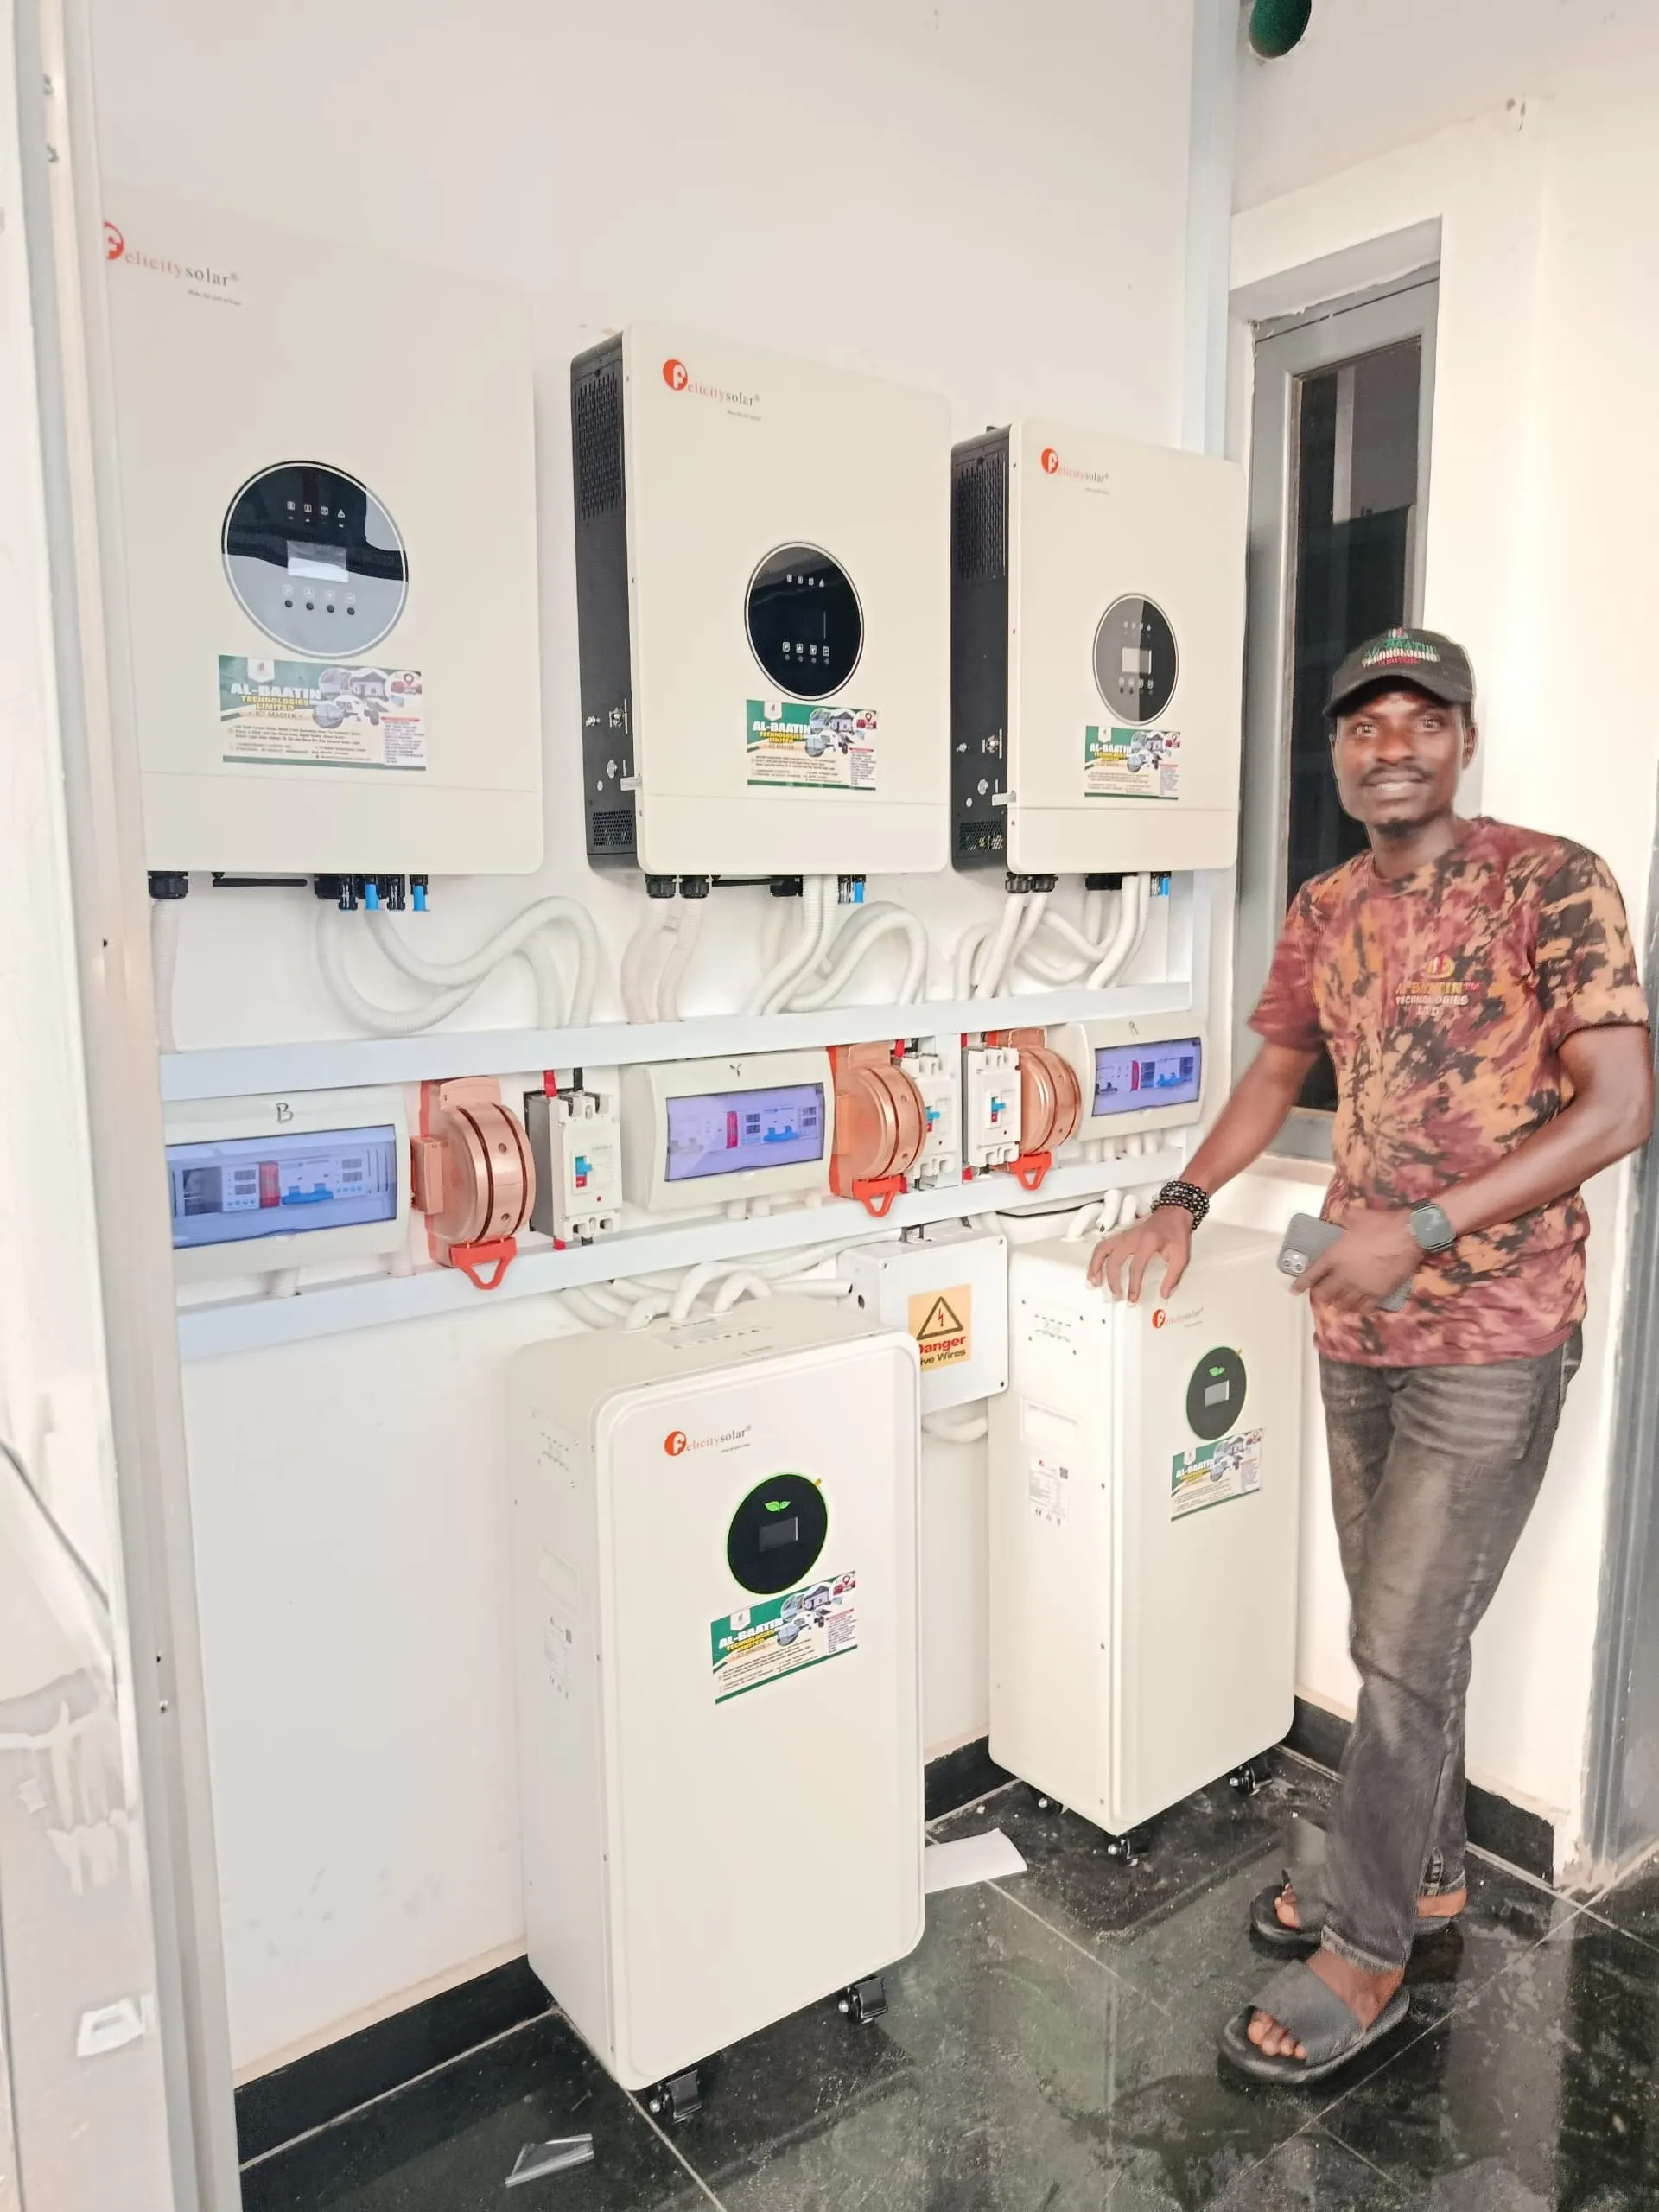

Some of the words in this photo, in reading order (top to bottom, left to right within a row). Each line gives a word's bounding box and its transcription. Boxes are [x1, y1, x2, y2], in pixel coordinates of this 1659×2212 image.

[276, 1102, 294, 1122] B
[920, 1356, 935, 1366] ive
[937, 1349, 966, 1361] Wires
